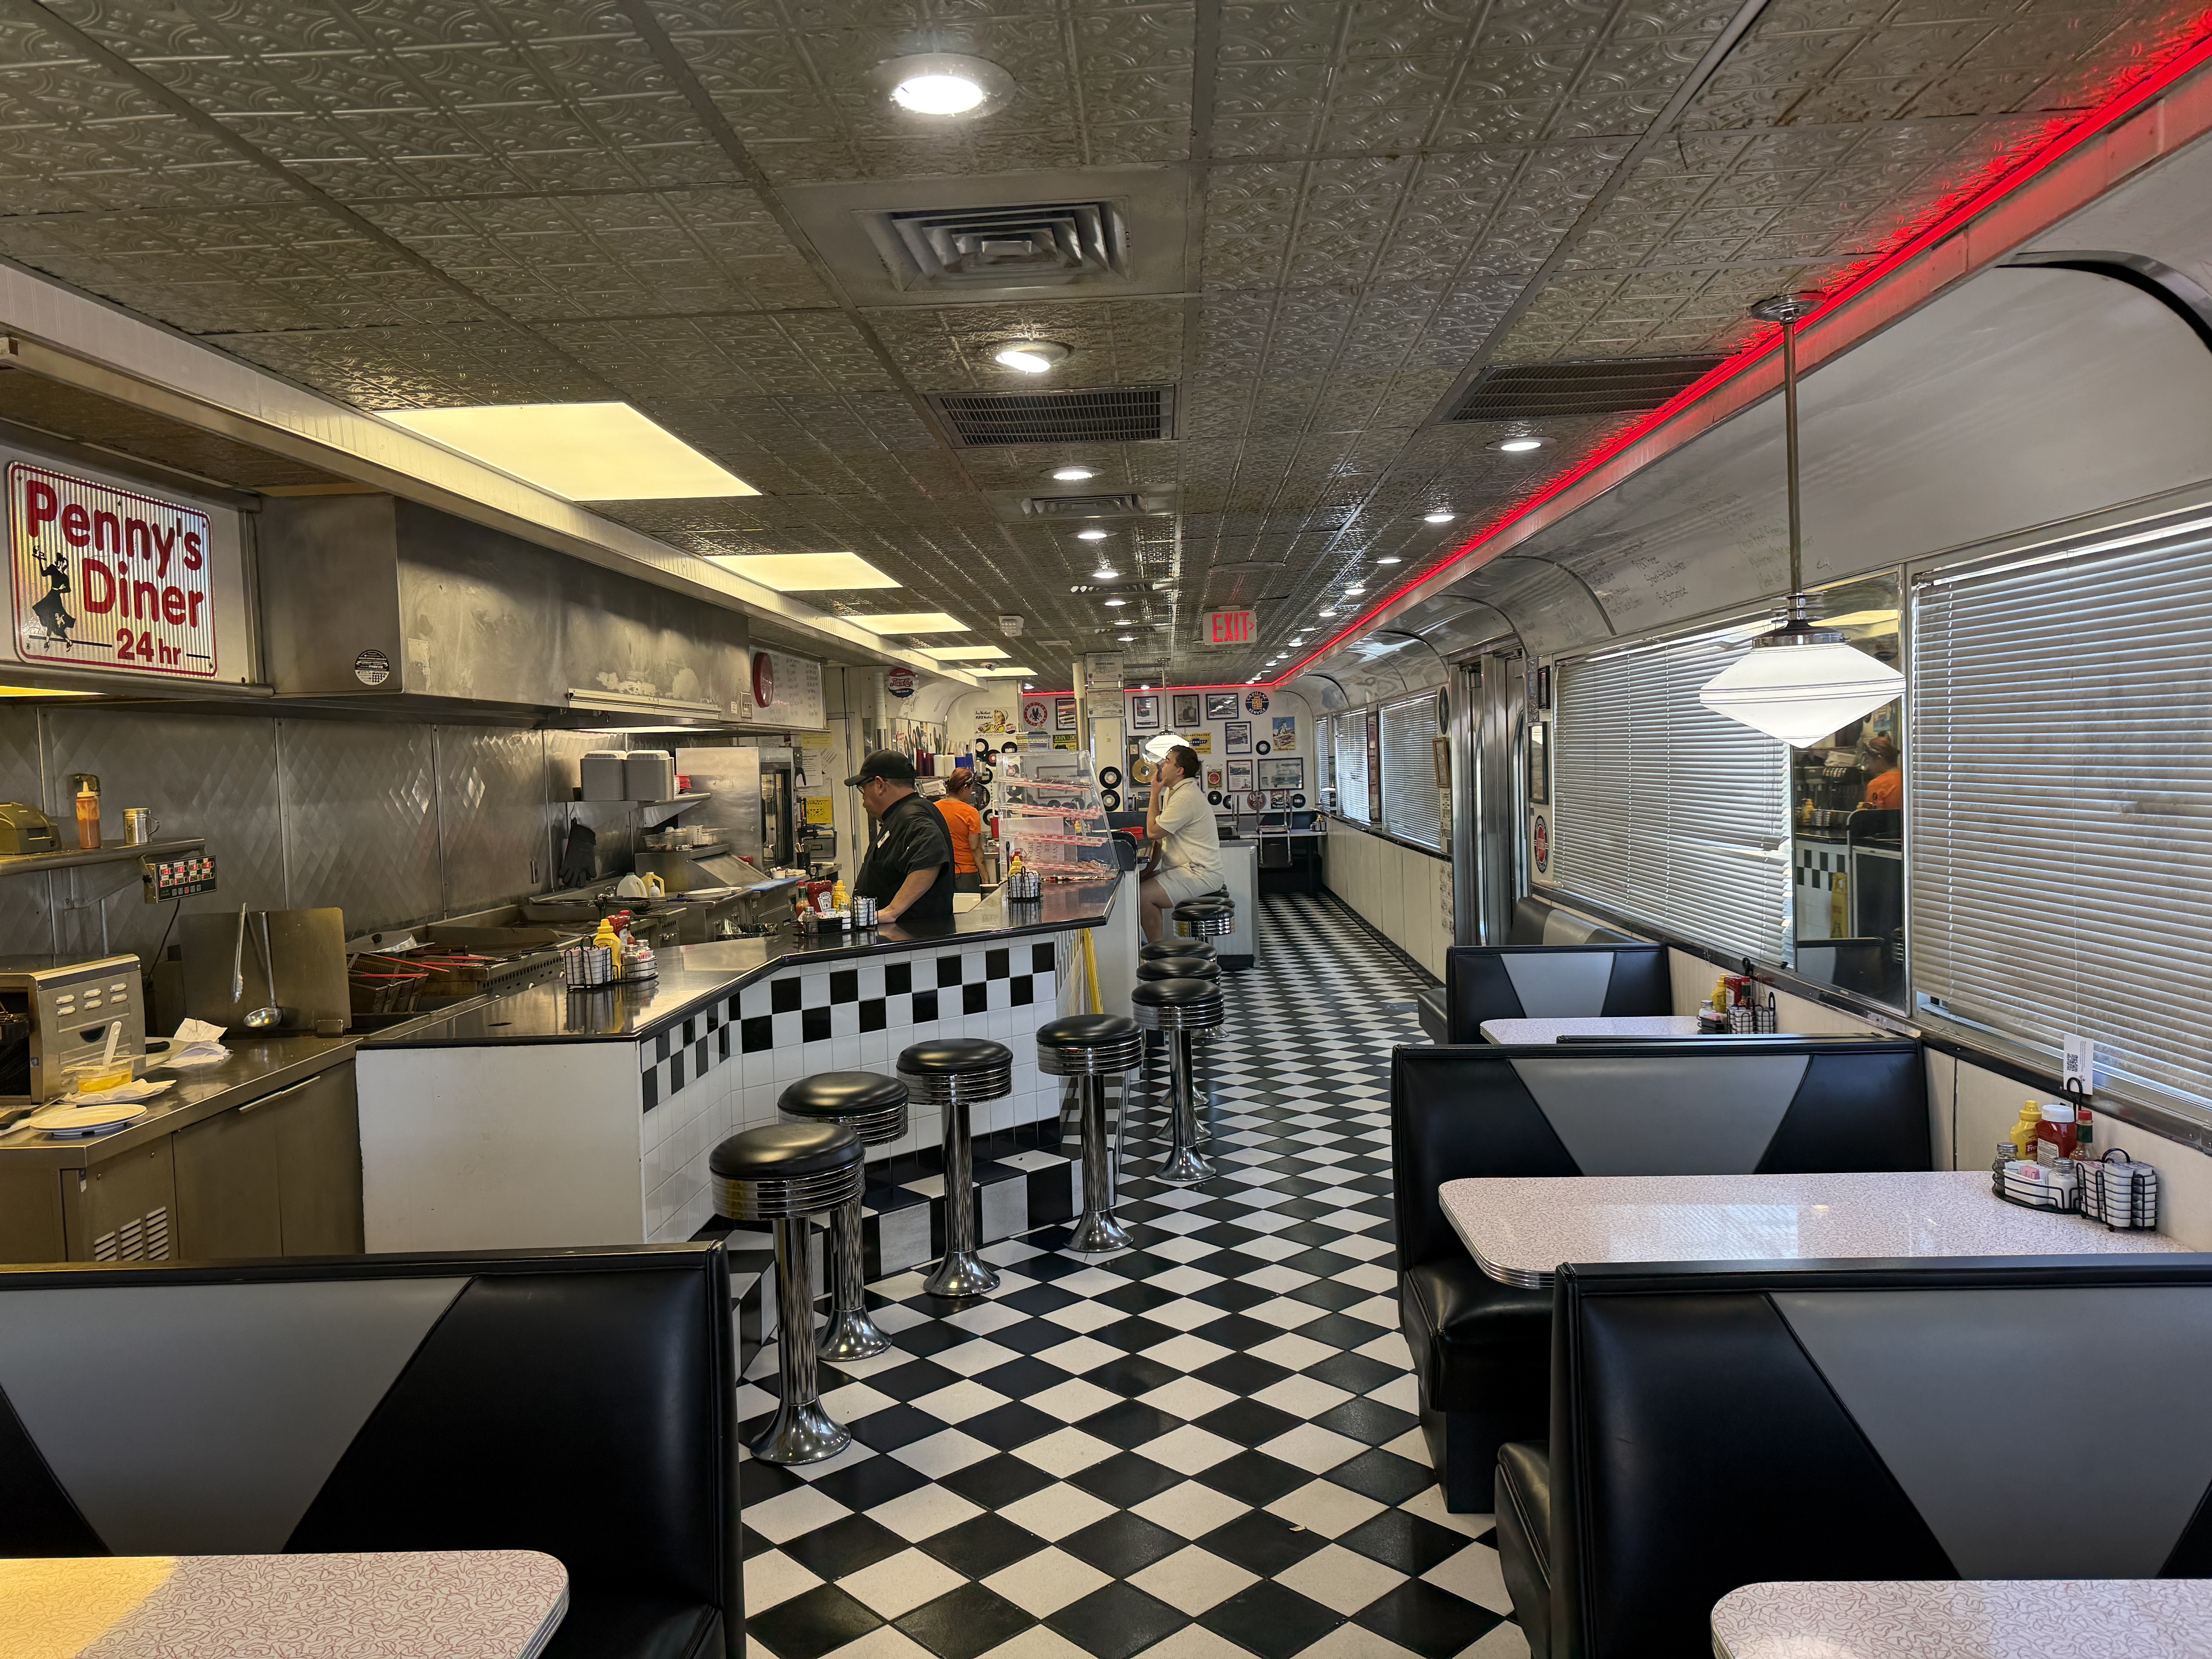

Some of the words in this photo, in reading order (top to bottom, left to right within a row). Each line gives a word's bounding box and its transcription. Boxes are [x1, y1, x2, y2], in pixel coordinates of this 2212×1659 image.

[27, 479, 203, 579] Penny's
[82, 558, 204, 628] Diner
[1212, 611, 1250, 642] EXIT
[117, 628, 155, 663] 24
[158, 638, 181, 665] hr
[1247, 692, 1267, 701] CADILLAC
